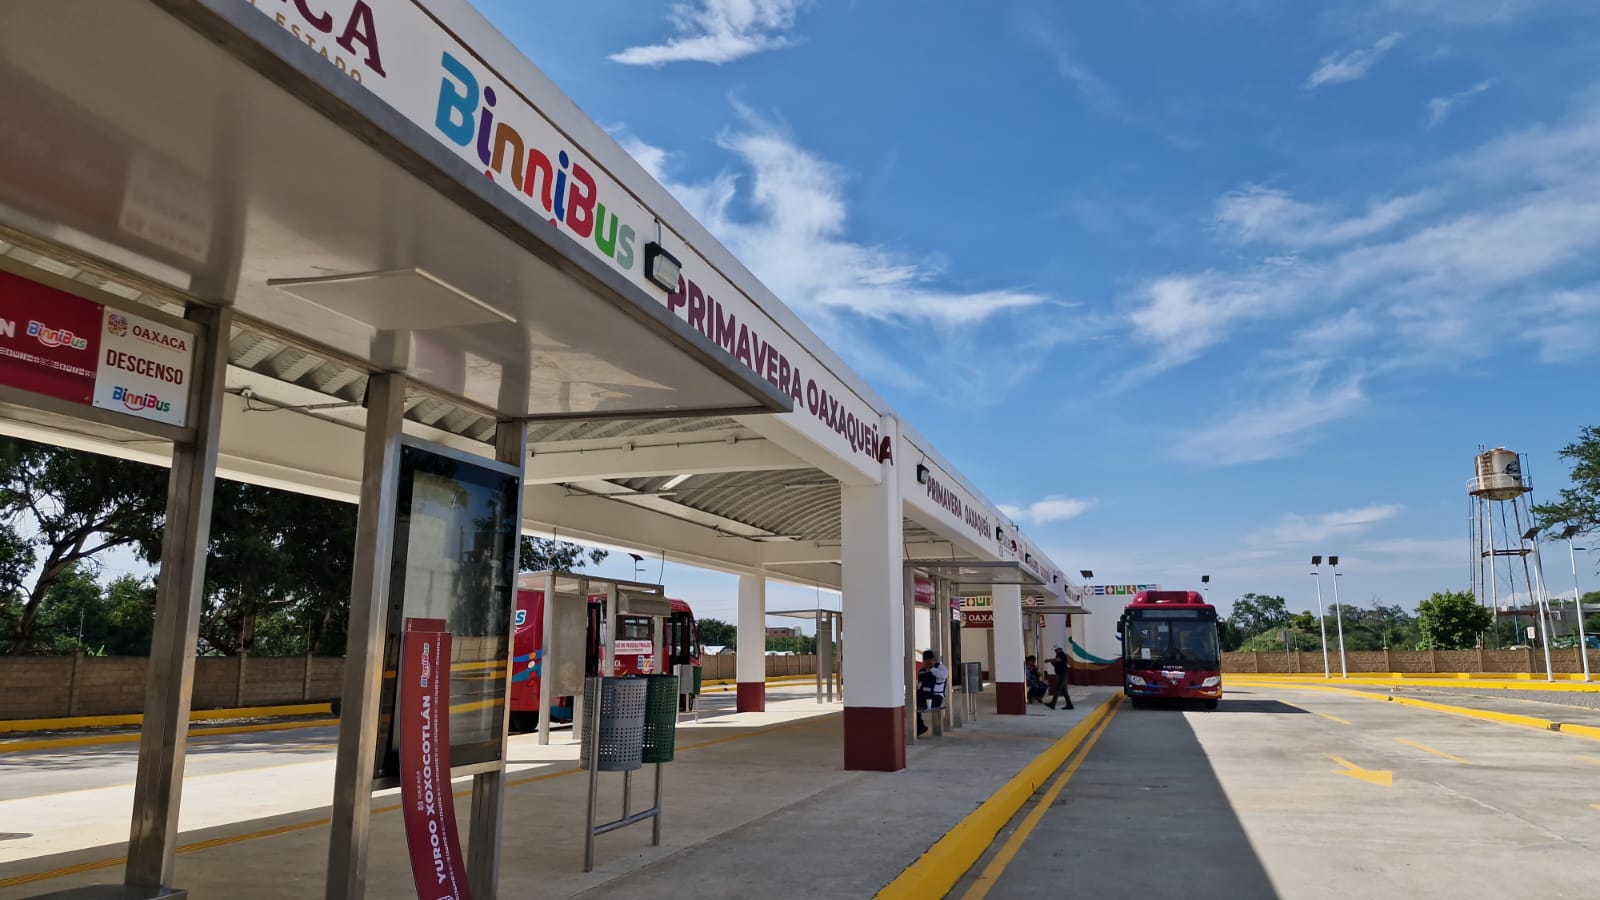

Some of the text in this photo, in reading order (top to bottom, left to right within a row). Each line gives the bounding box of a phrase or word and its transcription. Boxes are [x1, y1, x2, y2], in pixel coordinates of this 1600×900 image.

[434, 50, 636, 270] BinniBus
[27, 320, 88, 350] BinniBus
[132, 325, 187, 351] OAXACA
[106, 349, 183, 385] DESCENSO
[667, 273, 894, 466] PRIMAVERA OAXAQUEÑA
[112, 386, 170, 412] BinniBus
[926, 476, 962, 521] PRIMAVERA
[420, 695, 447, 884] YUROO XOXOCOTLÁN
